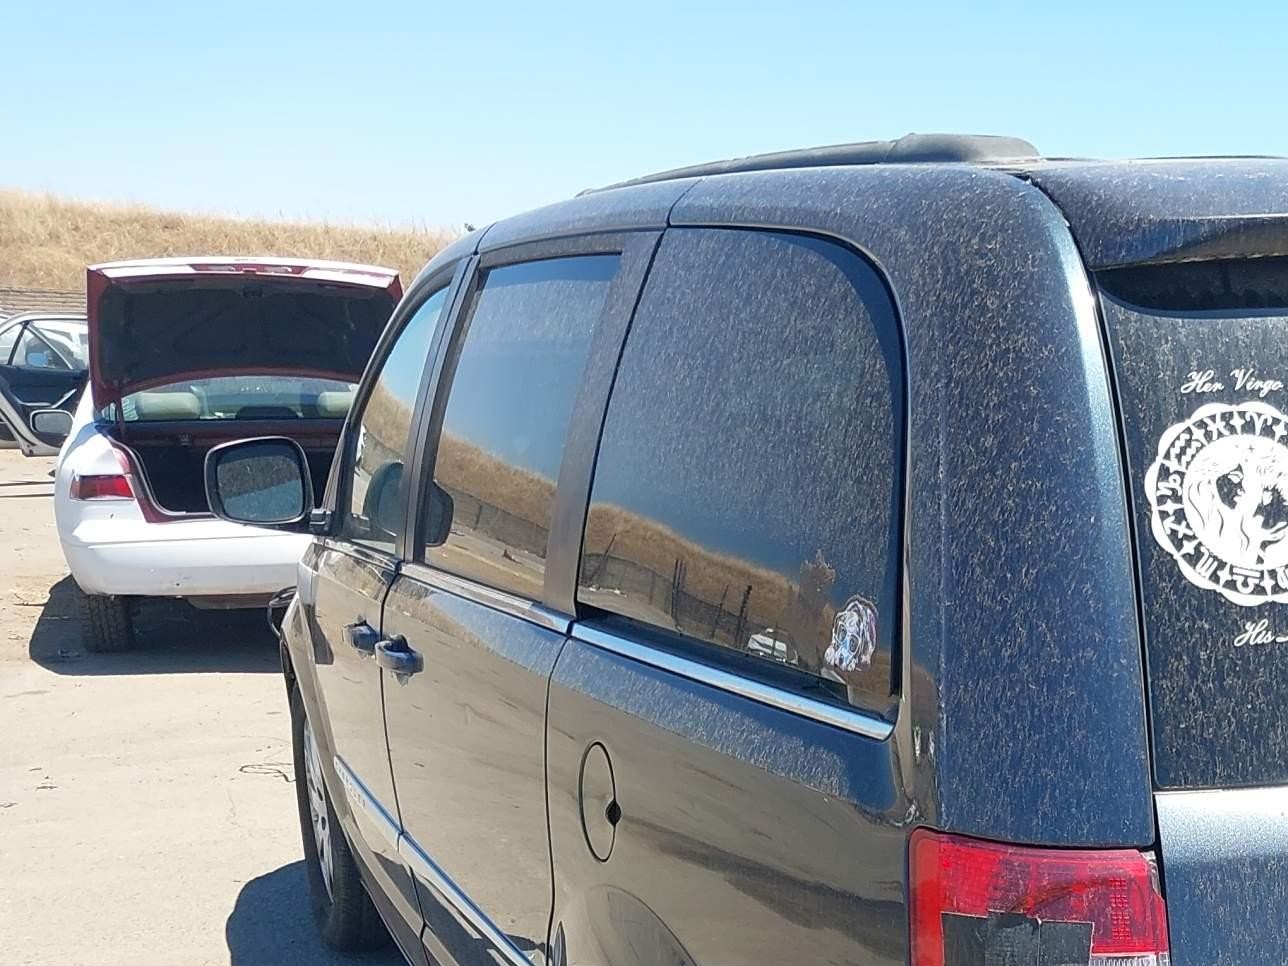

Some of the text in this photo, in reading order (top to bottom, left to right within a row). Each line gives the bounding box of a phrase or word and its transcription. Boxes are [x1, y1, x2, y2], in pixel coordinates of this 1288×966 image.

[1180, 366, 1284, 398] Her Virgo
[1234, 618, 1275, 647] His
